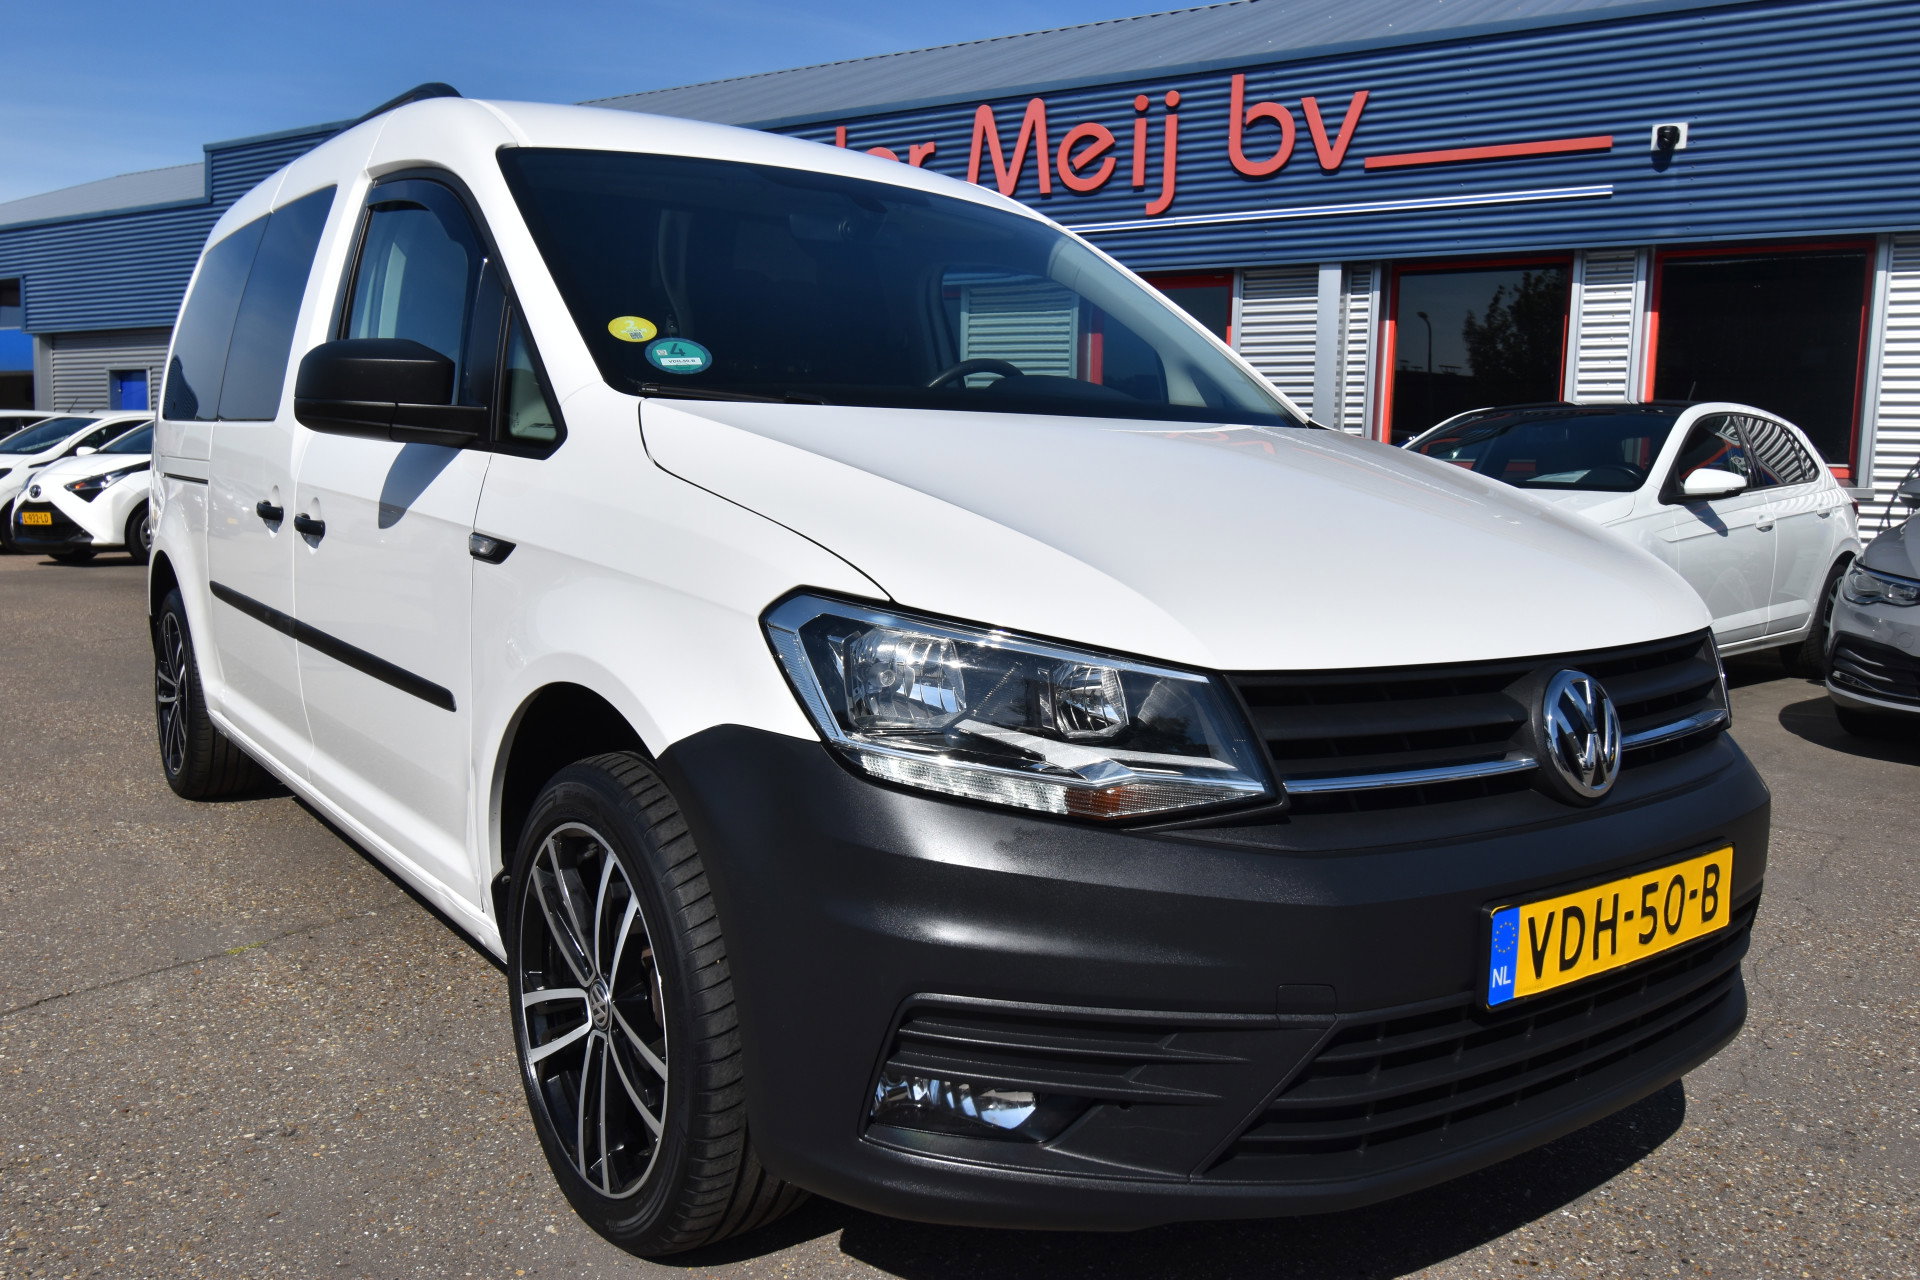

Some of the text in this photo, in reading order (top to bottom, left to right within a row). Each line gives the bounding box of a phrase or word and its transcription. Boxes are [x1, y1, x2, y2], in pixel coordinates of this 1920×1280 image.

[966, 73, 1370, 215] Meij bv
[670, 343, 686, 356] 4
[1492, 862, 1721, 988] NL VDH-50-B
